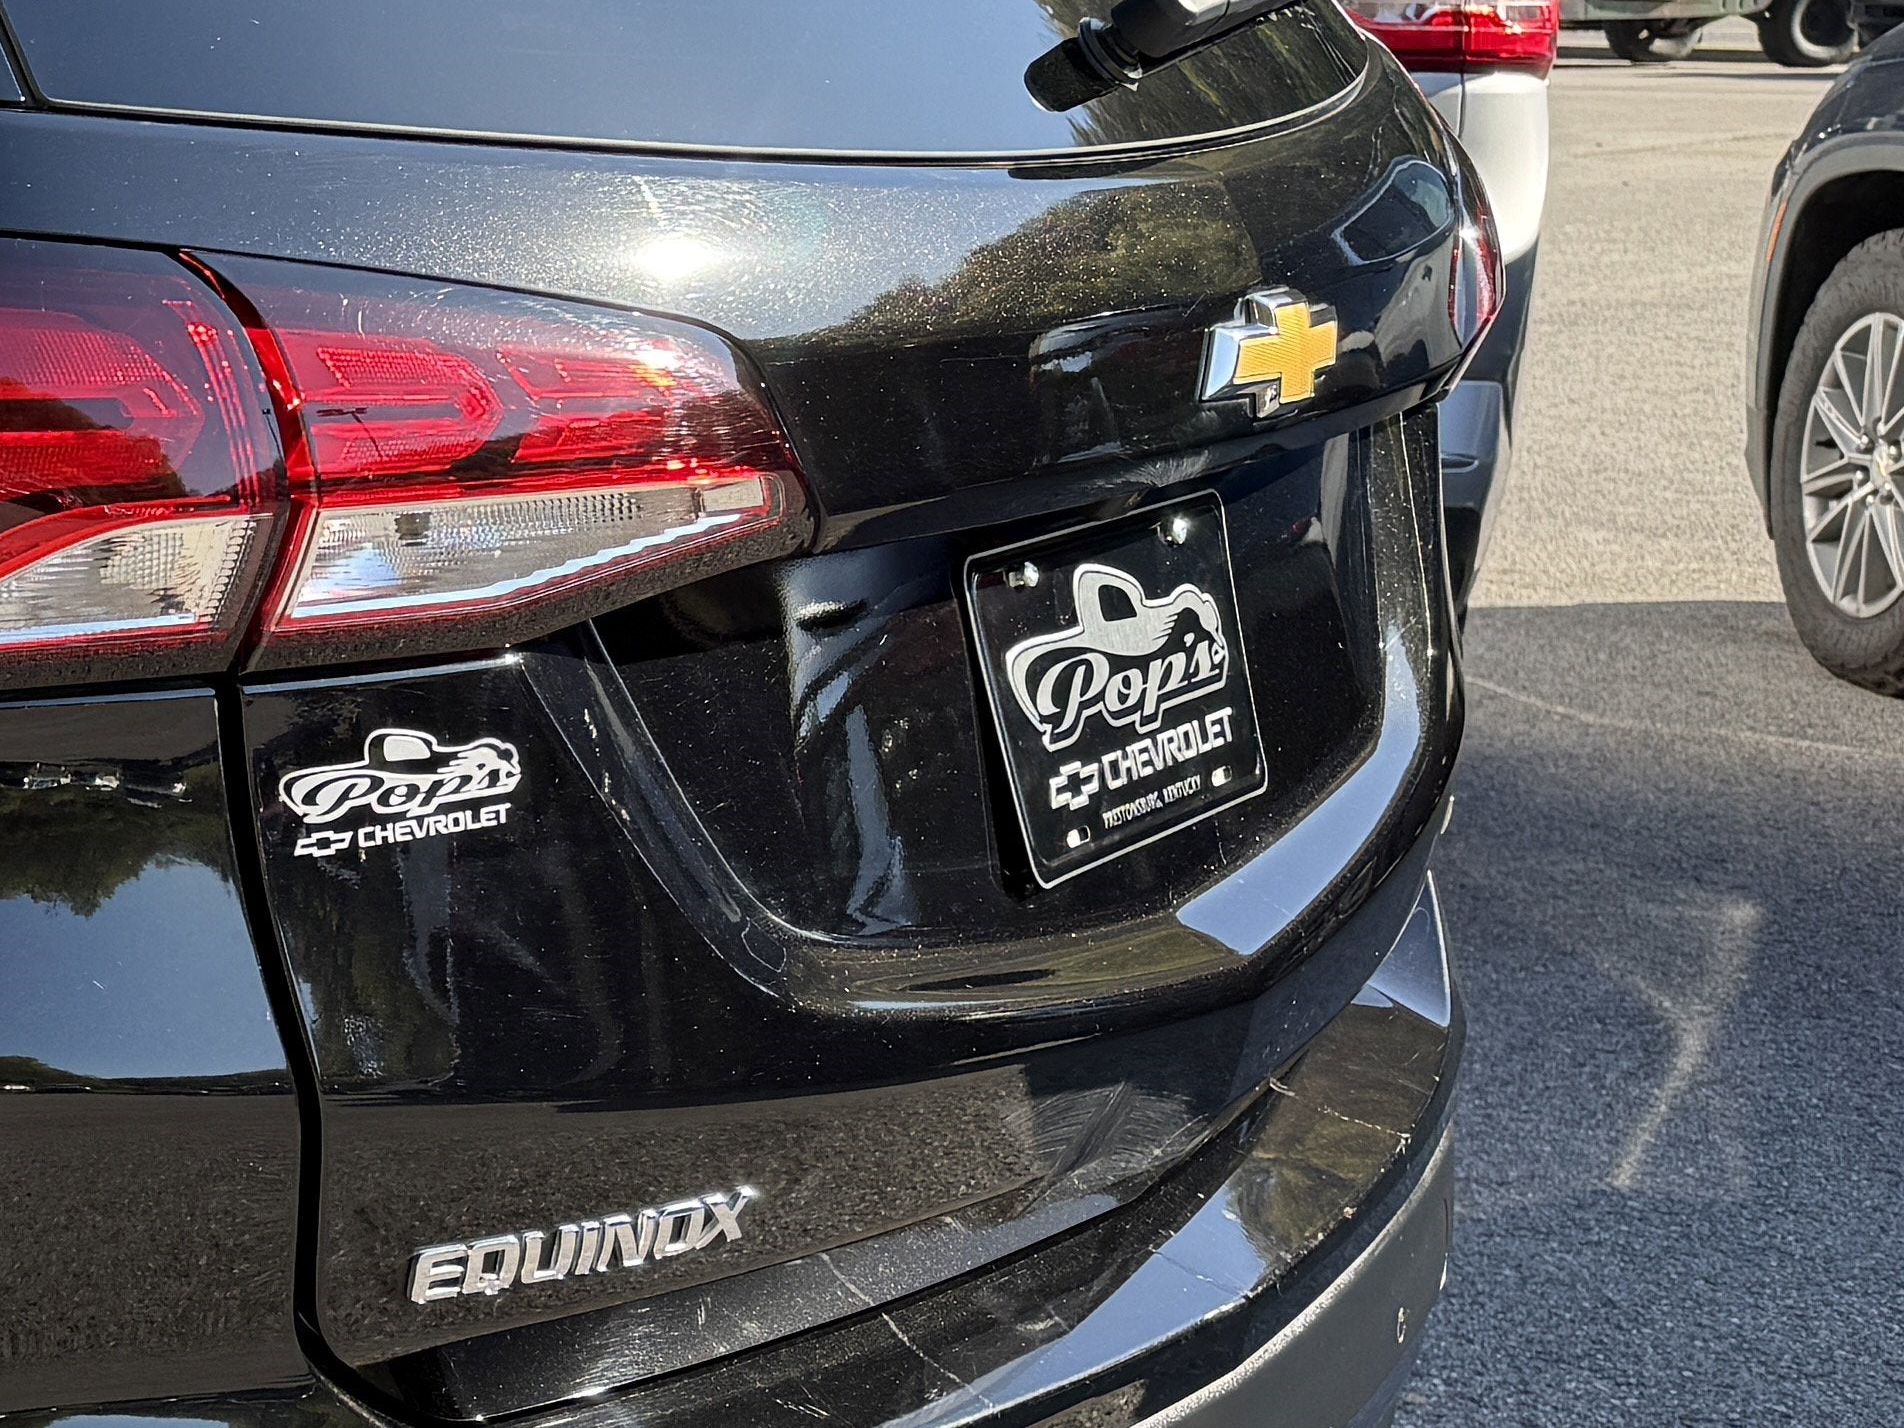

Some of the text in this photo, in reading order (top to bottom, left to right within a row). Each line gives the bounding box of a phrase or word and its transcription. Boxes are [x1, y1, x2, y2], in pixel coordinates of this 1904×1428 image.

[1035, 630, 1224, 733] Pop's
[1100, 706, 1234, 790] CHEVROLET
[357, 803, 513, 848] CHEVROLET
[407, 1184, 755, 1304] EQUINOX
